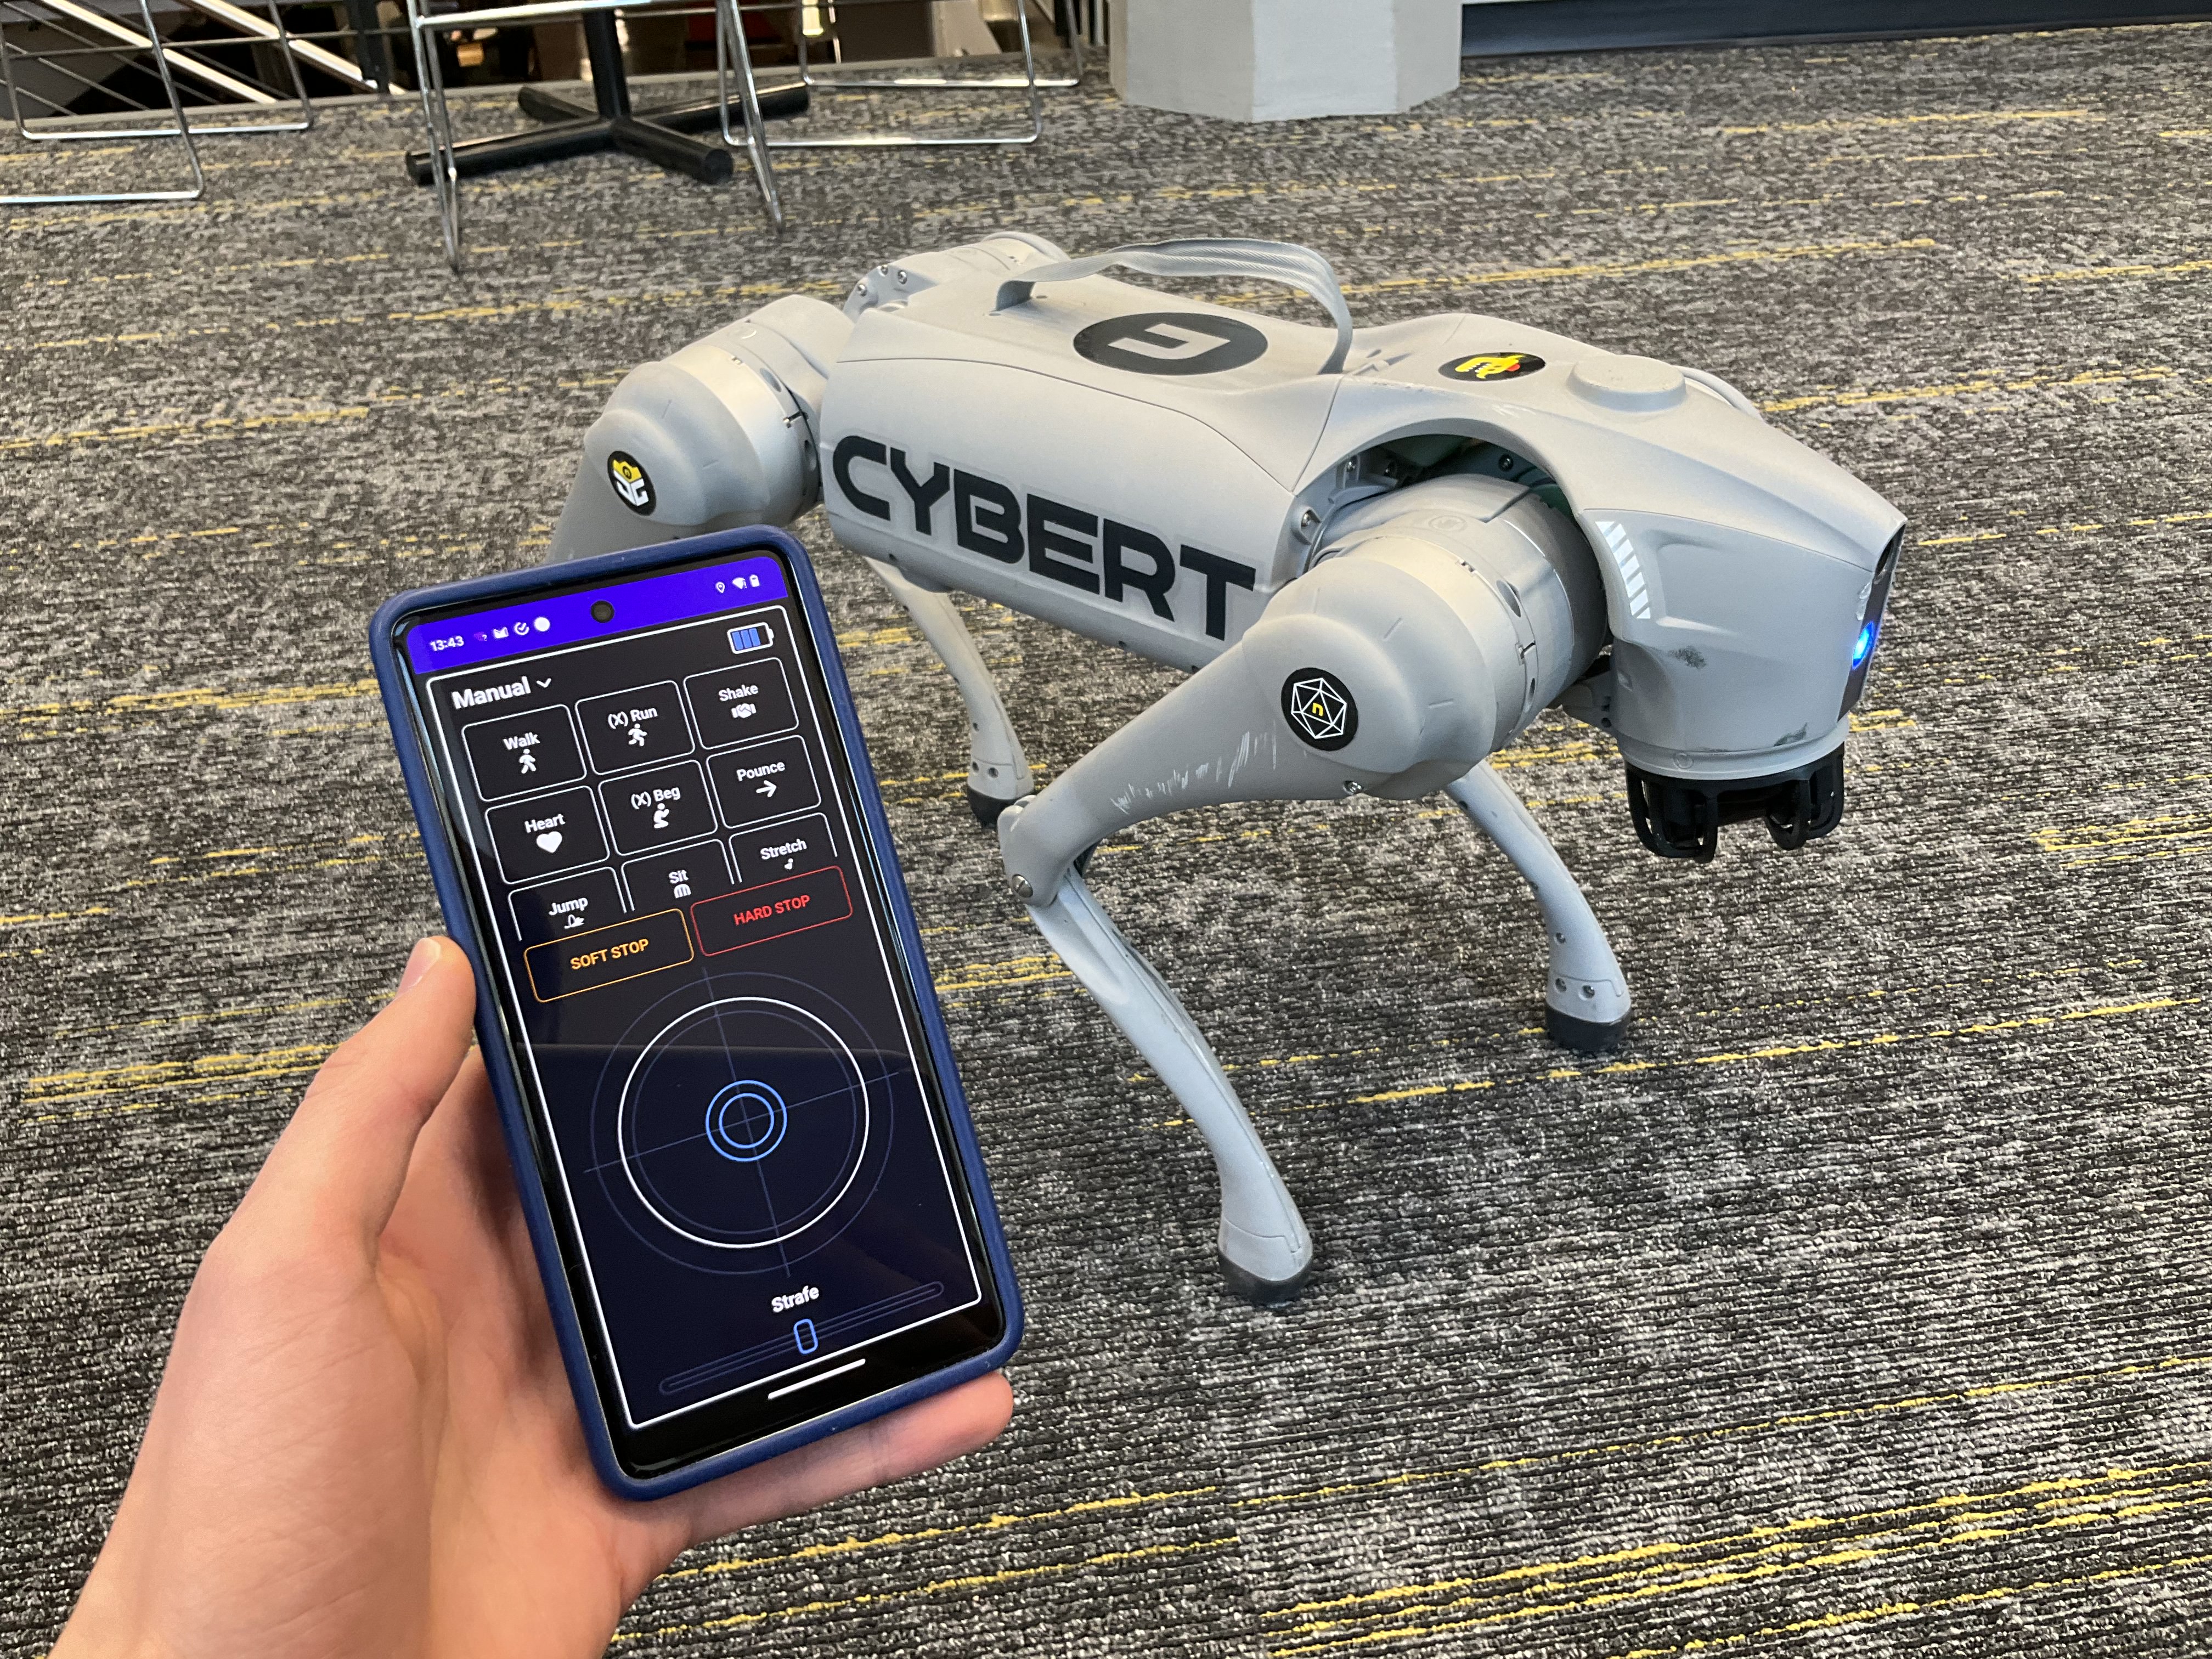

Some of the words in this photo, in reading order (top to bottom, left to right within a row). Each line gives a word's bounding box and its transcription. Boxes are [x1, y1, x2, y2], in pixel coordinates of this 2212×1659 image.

[832, 435, 1256, 641] CYBERT
[430, 636, 464, 651] 13:43
[452, 676, 531, 709] Manual
[718, 684, 759, 702] Shake
[608, 712, 629, 729] (X)
[630, 708, 658, 722] Run
[503, 732, 540, 749] Walk
[736, 761, 786, 781] Pounce
[631, 792, 652, 809] (X)
[653, 787, 681, 801] Beg
[524, 813, 565, 833] Heart
[760, 839, 807, 860] Stretch
[669, 870, 689, 884] Sit
[549, 897, 589, 916] Jump
[733, 905, 772, 925] HARD
[775, 895, 810, 914] STOP
[570, 950, 608, 970] SOFT
[611, 938, 649, 959] STOP
[771, 1285, 820, 1313] Strafe
